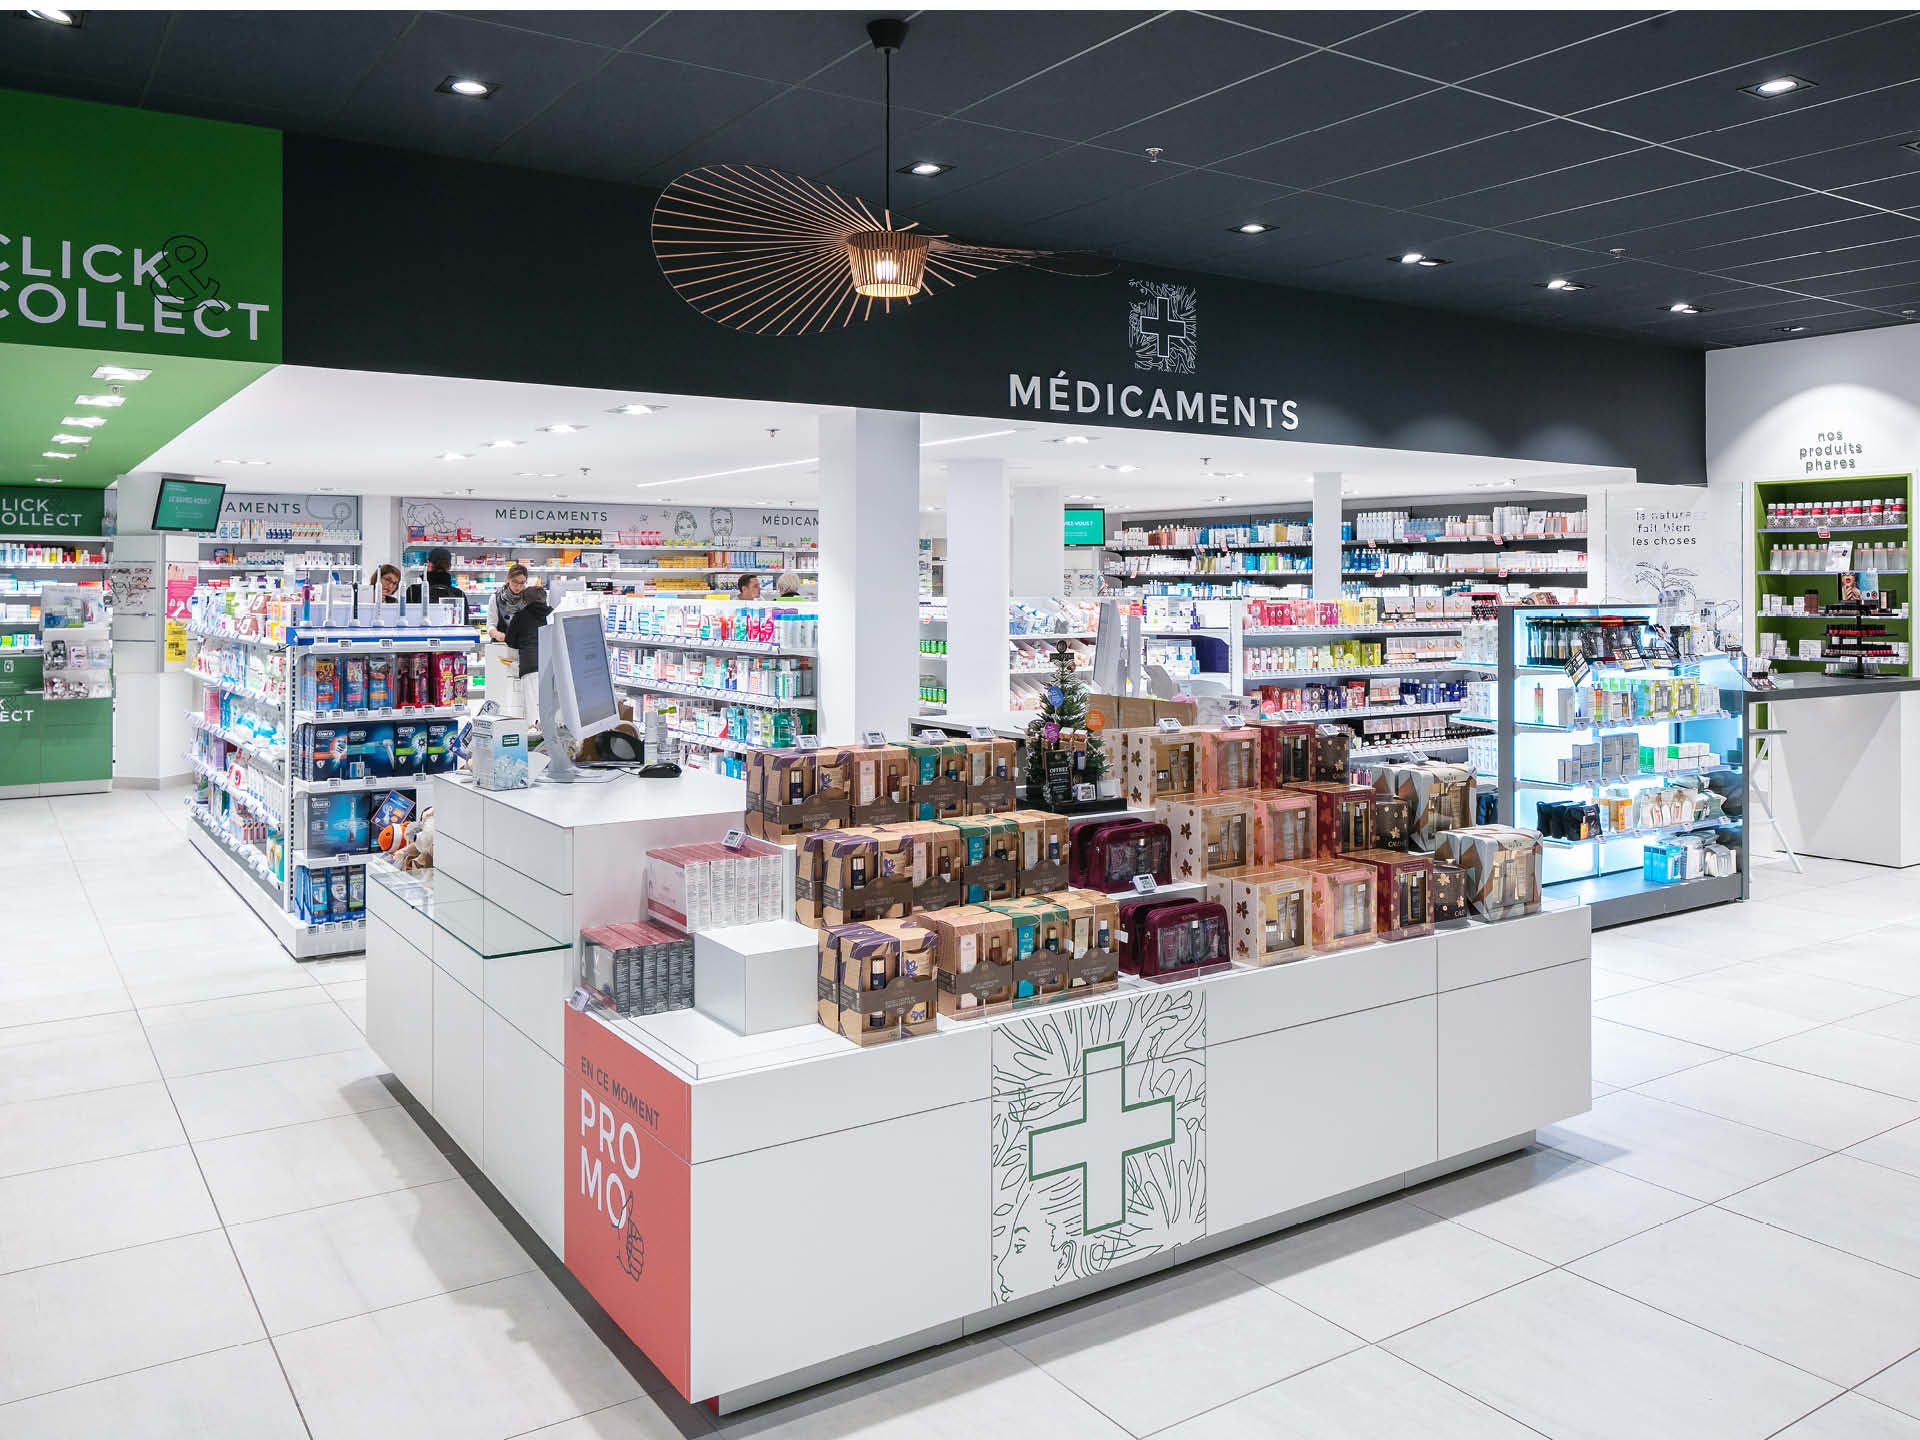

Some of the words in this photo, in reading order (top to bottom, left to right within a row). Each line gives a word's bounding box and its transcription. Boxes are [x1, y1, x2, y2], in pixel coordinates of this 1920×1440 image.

[0, 233, 168, 289] LICK
[0, 280, 269, 341] OLLECT
[1008, 370, 1299, 431] MÉDICAMENTS
[1799, 442, 1863, 460] produits
[1817, 431, 1843, 442] nos
[1805, 458, 1856, 474] phares
[225, 501, 301, 514] AMENTS
[495, 507, 608, 522] MÉDICAMENTS
[1632, 537, 1649, 546] les
[1653, 536, 1697, 546] choses
[581, 1055, 594, 1081] EN
[596, 1067, 609, 1092] CE
[612, 1079, 660, 1131] MOMENT
[581, 1087, 641, 1179] PRO
[580, 1144, 627, 1230] MO
